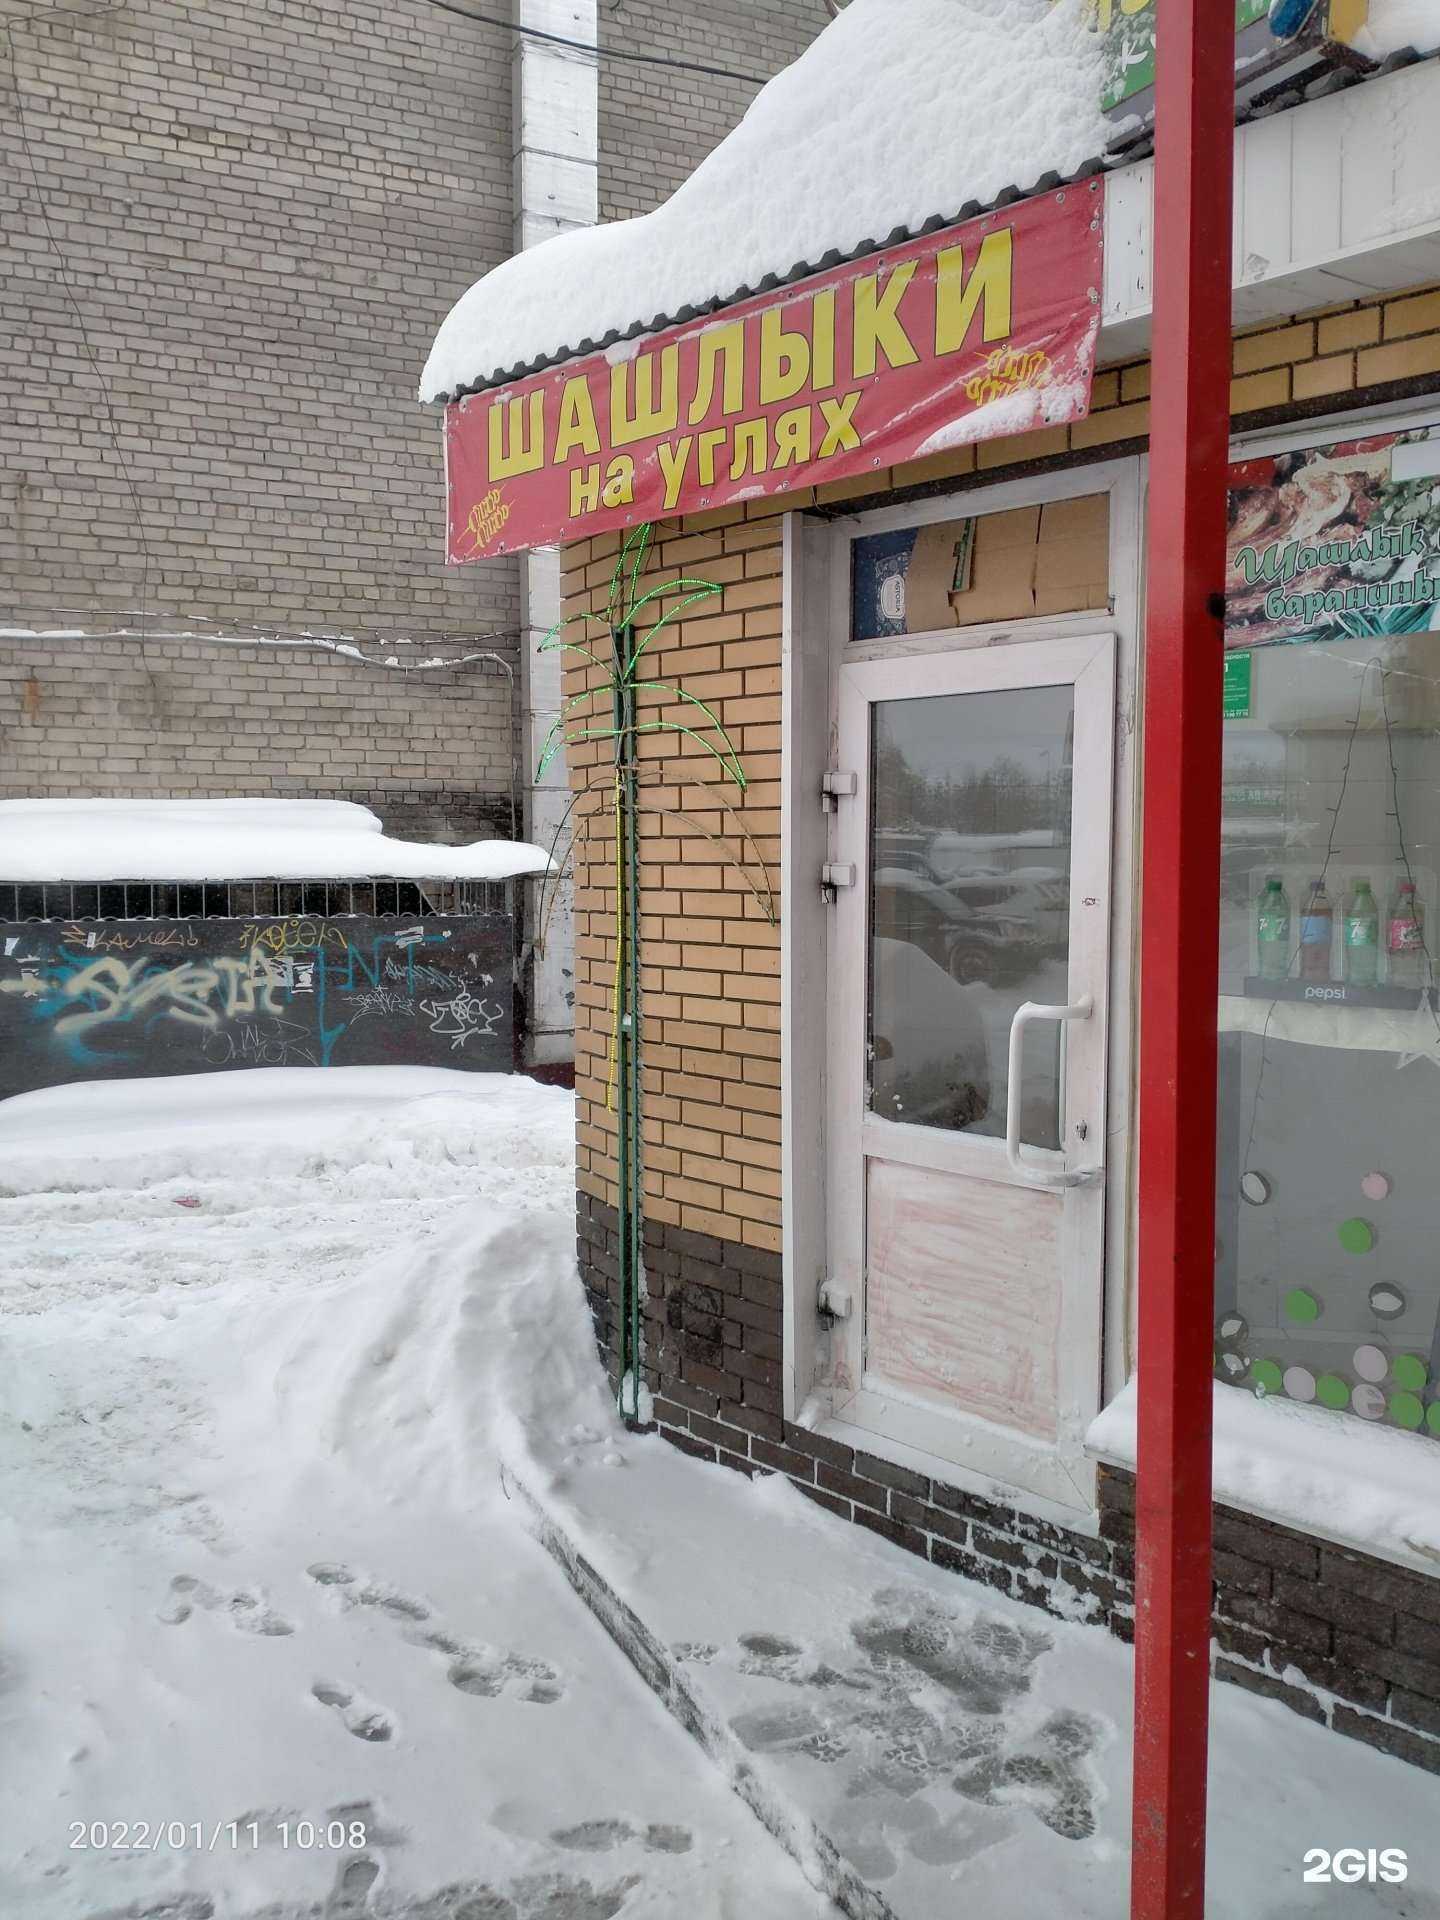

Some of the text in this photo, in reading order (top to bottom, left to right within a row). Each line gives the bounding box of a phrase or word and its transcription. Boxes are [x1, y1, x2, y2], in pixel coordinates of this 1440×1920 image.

[487, 228, 1013, 482] ШАШЛЫКИ
[568, 392, 863, 518] на углях
[1235, 520, 1424, 585] Шашлык
[1304, 986, 1345, 1000] pepsi
